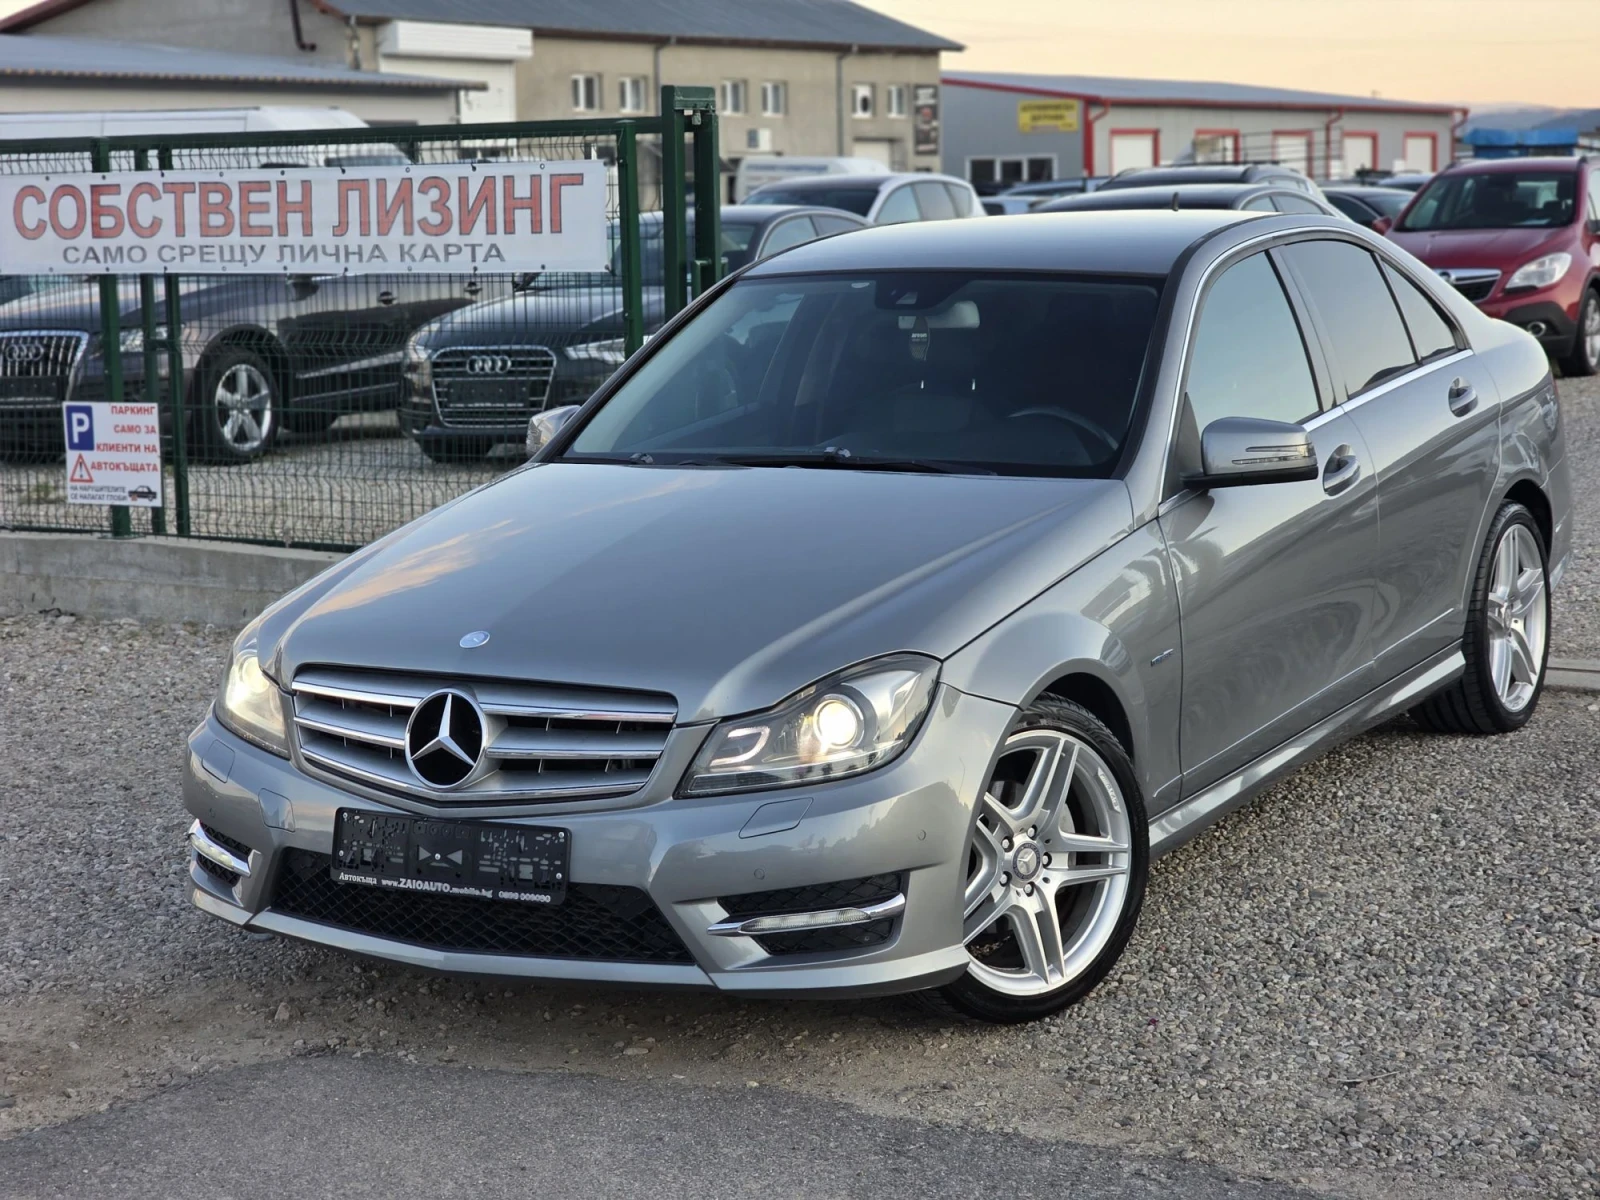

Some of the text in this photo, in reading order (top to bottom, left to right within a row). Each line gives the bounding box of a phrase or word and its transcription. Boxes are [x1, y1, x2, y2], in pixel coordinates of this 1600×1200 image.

[13, 173, 584, 240] СОБСТВЕН ЛИЗИНГ
[62, 242, 507, 265] САМО СРЕЩУ ЛИЧНА КАРТА
[111, 405, 156, 415] ПАРКИНГ
[71, 412, 90, 444] P
[113, 424, 157, 434] САМО ЗА
[96, 443, 158, 453] КЛИЕНТИ НА
[91, 461, 158, 472] АВТОКЪЩАТА
[339, 872, 378, 885] Автокъща
